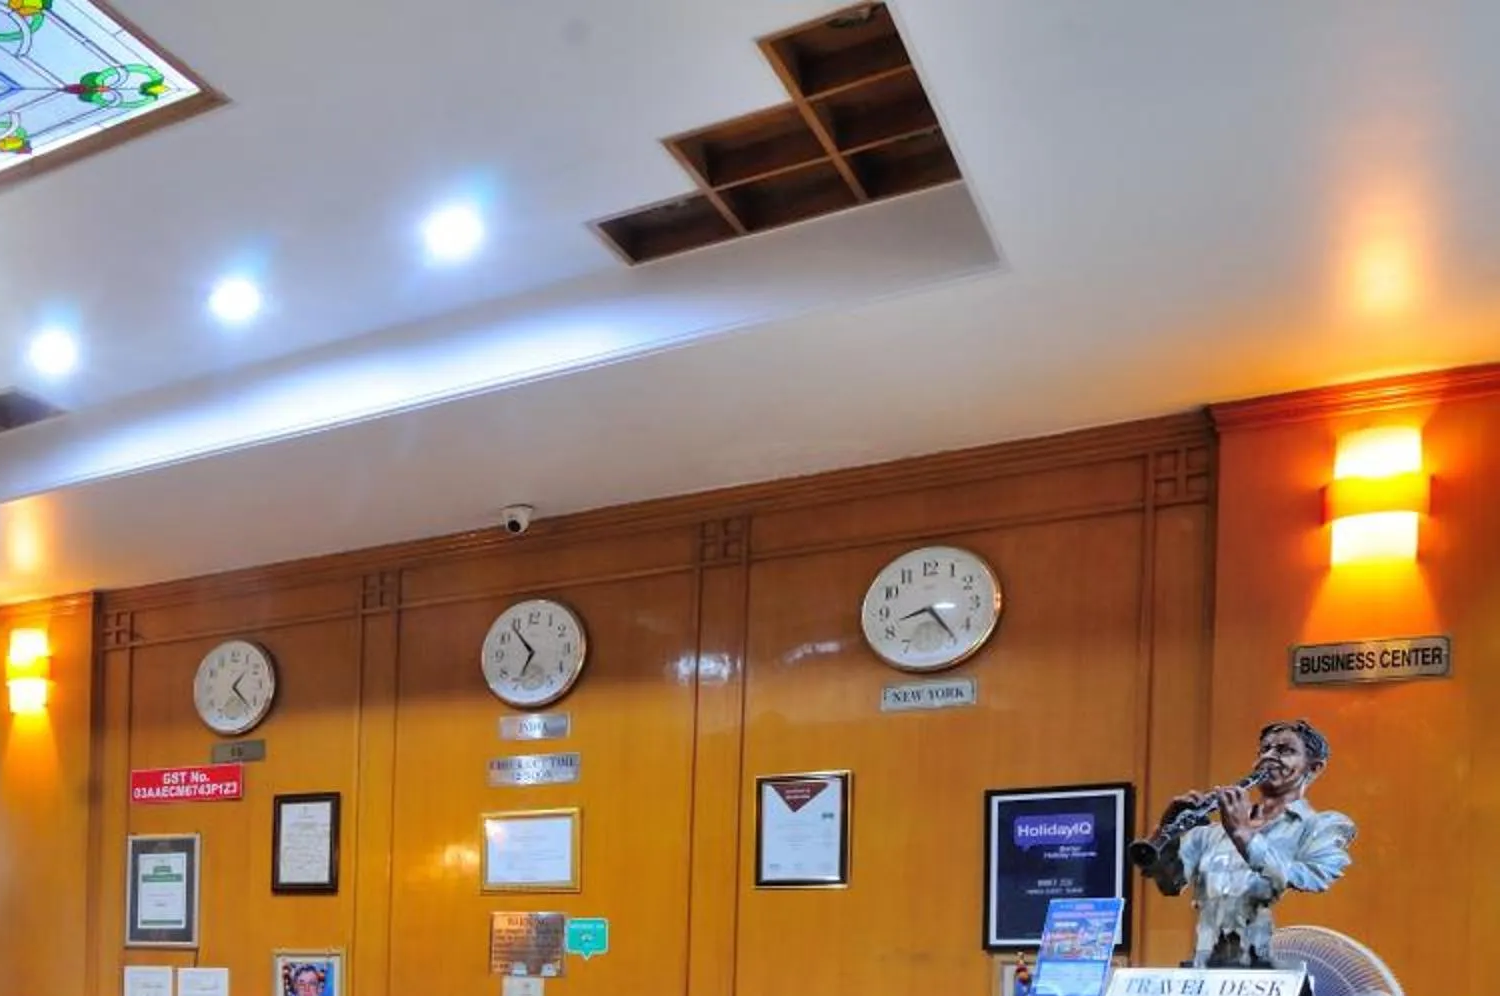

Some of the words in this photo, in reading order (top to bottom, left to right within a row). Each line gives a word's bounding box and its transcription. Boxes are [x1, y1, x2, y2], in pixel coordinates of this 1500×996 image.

[923, 560, 939, 576] 12
[949, 562, 955, 577] 1
[901, 569, 912, 584] 11
[962, 575, 973, 590] 2
[885, 585, 898, 600] 10
[970, 595, 980, 610] 3
[529, 610, 541, 625] 12
[547, 613, 553, 627] 1
[879, 607, 889, 621] 9
[885, 625, 896, 640] 8
[901, 639, 910, 653] 7
[1299, 650, 1376, 675] BUSINESS
[1379, 646, 1444, 669] CENTER
[891, 688, 923, 703] NEW
[926, 686, 965, 701] YORK
[163, 771, 187, 784] GST
[190, 770, 210, 782] No.
[1017, 821, 1092, 839] HolidayIQ
[1125, 977, 1209, 996] TRAVEL
[1218, 979, 1285, 996] DESK
